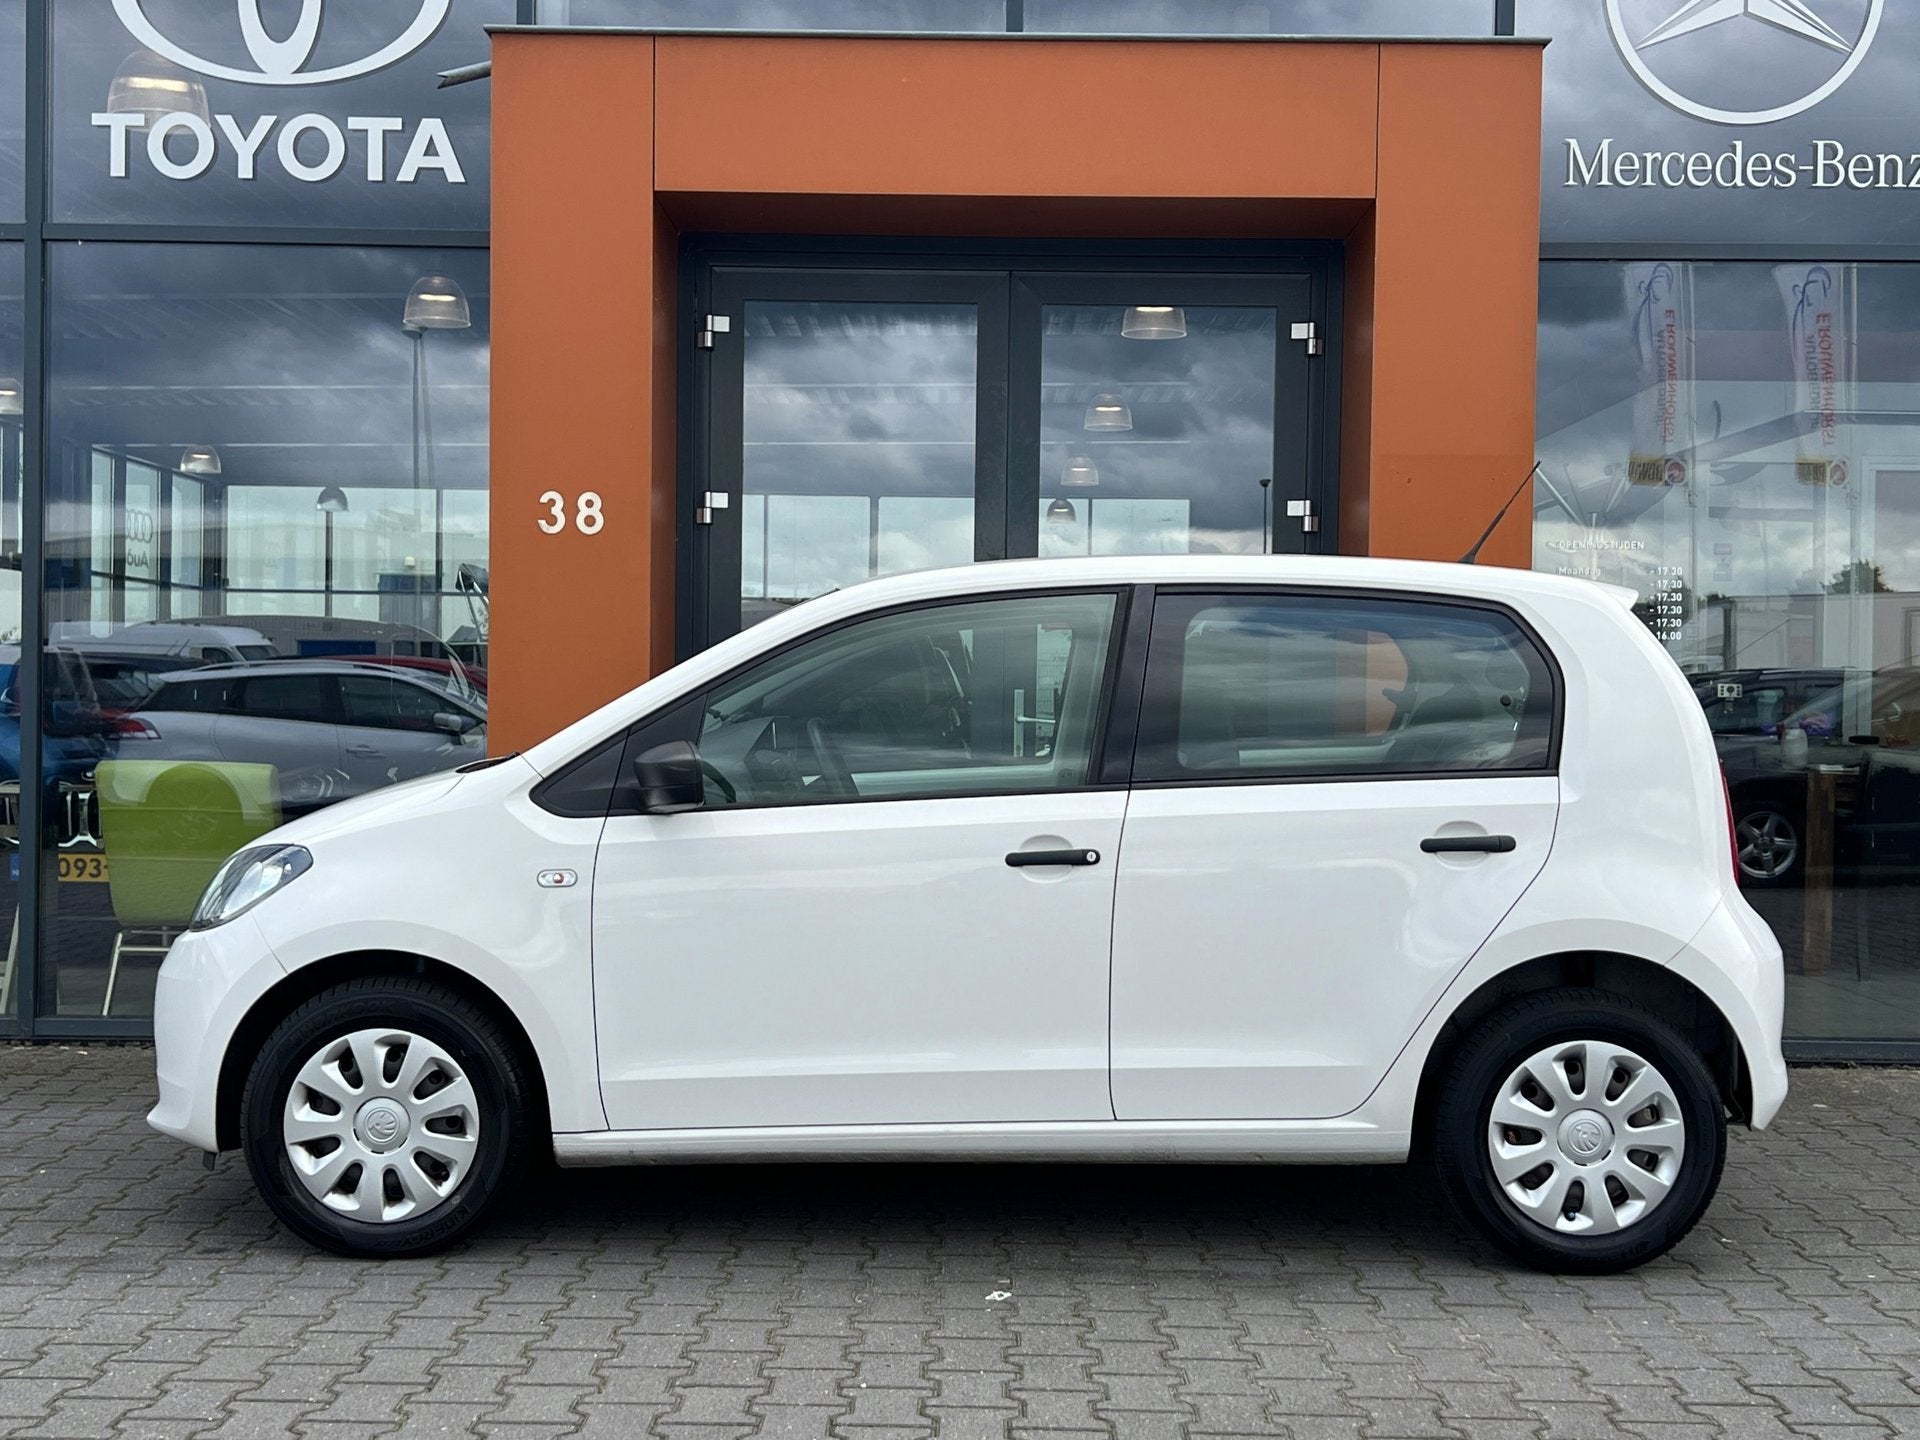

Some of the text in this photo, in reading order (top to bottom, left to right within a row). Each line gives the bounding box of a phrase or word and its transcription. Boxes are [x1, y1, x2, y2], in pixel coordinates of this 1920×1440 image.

[91, 112, 466, 183] TOYOTA
[1564, 138, 1920, 188] Mercedes-Benz
[1559, 540, 1645, 550] OPENINGSTIJDEN
[1558, 567, 1601, 577] Maandag
[1657, 566, 1683, 576] 17.30
[1657, 580, 1683, 588] 17.30
[1657, 593, 1683, 601] 17.30
[1656, 606, 1682, 614] 17.30
[1656, 619, 1682, 627] 17.30
[1656, 631, 1682, 640] 16.00
